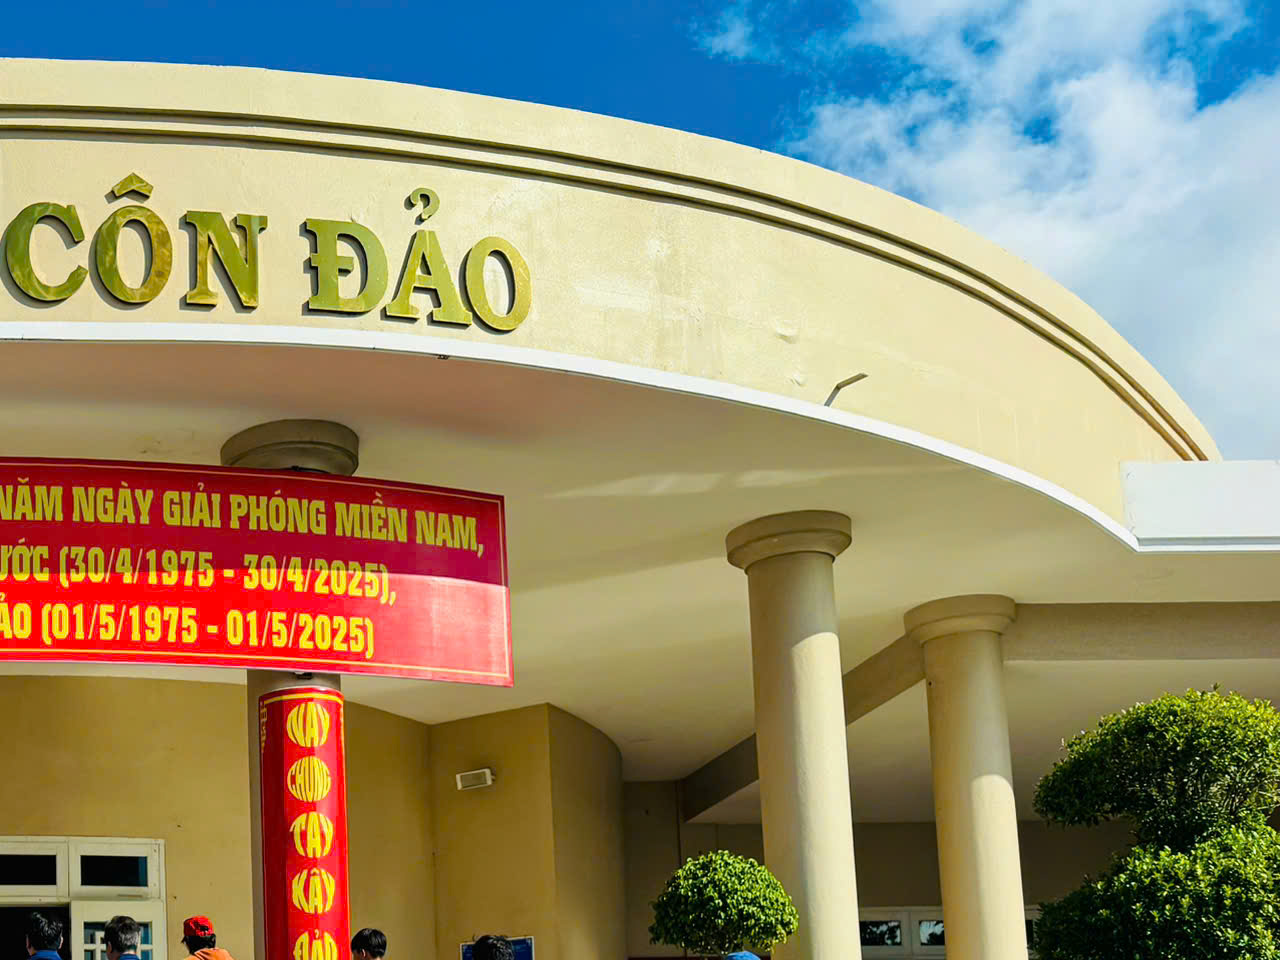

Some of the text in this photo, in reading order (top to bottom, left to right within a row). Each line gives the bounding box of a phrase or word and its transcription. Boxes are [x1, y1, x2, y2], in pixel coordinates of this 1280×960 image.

[6, 172, 268, 308] CÔN
[302, 187, 532, 331] ĐẢO
[71, 482, 154, 525] NGÀY
[162, 482, 221, 528] GIẢI
[229, 490, 327, 535] PHÓNG
[334, 491, 408, 543] MIỀN
[414, 511, 484, 558] NAM,
[59, 547, 214, 588] (30/4/1975
[243, 554, 397, 606] 30/4/2025),
[41, 602, 198, 646] (01/5/1975
[226, 611, 375, 659] 01/5/2025)
[286, 702, 330, 748] NAY
[287, 756, 332, 802] CHUNG
[289, 811, 334, 858] TAY
